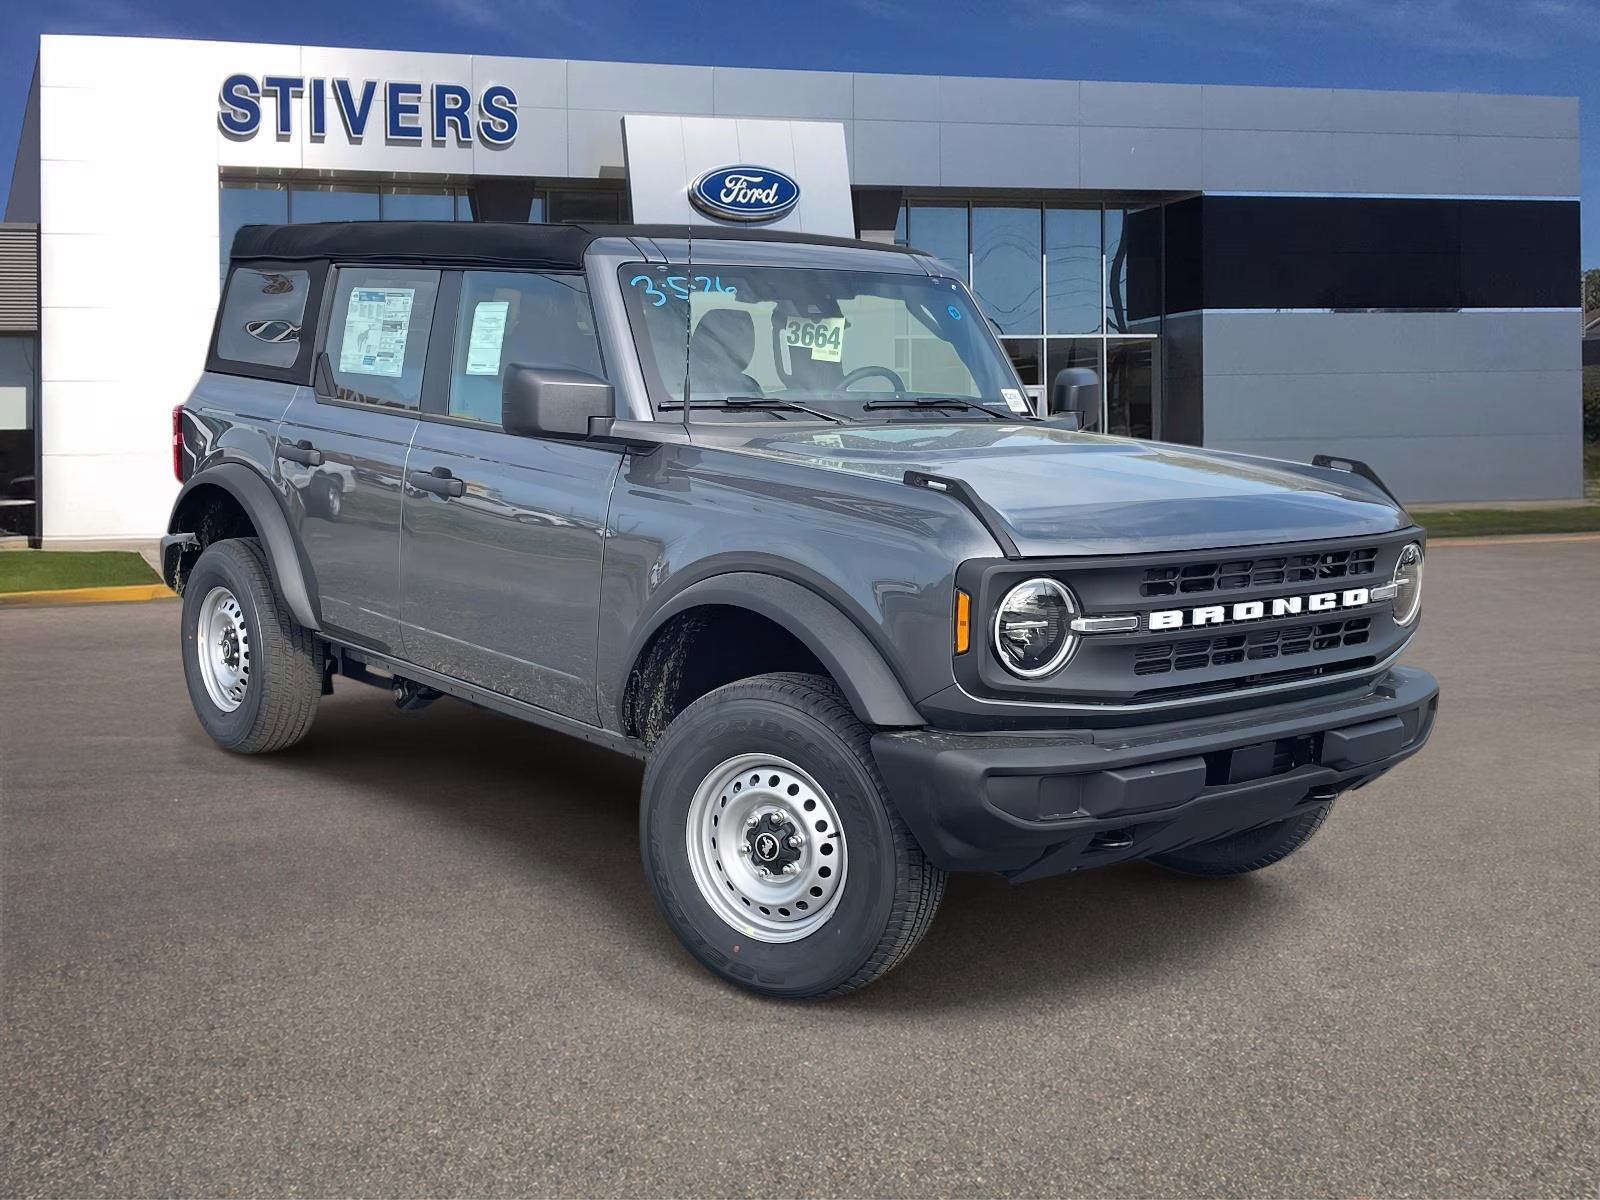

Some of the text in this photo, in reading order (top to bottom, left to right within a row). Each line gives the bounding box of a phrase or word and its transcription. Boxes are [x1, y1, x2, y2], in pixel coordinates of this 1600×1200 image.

[218, 74, 519, 146] STIVERS
[720, 174, 779, 204] Ford
[786, 320, 841, 350] 3664
[1148, 588, 1369, 630] BRONCO
